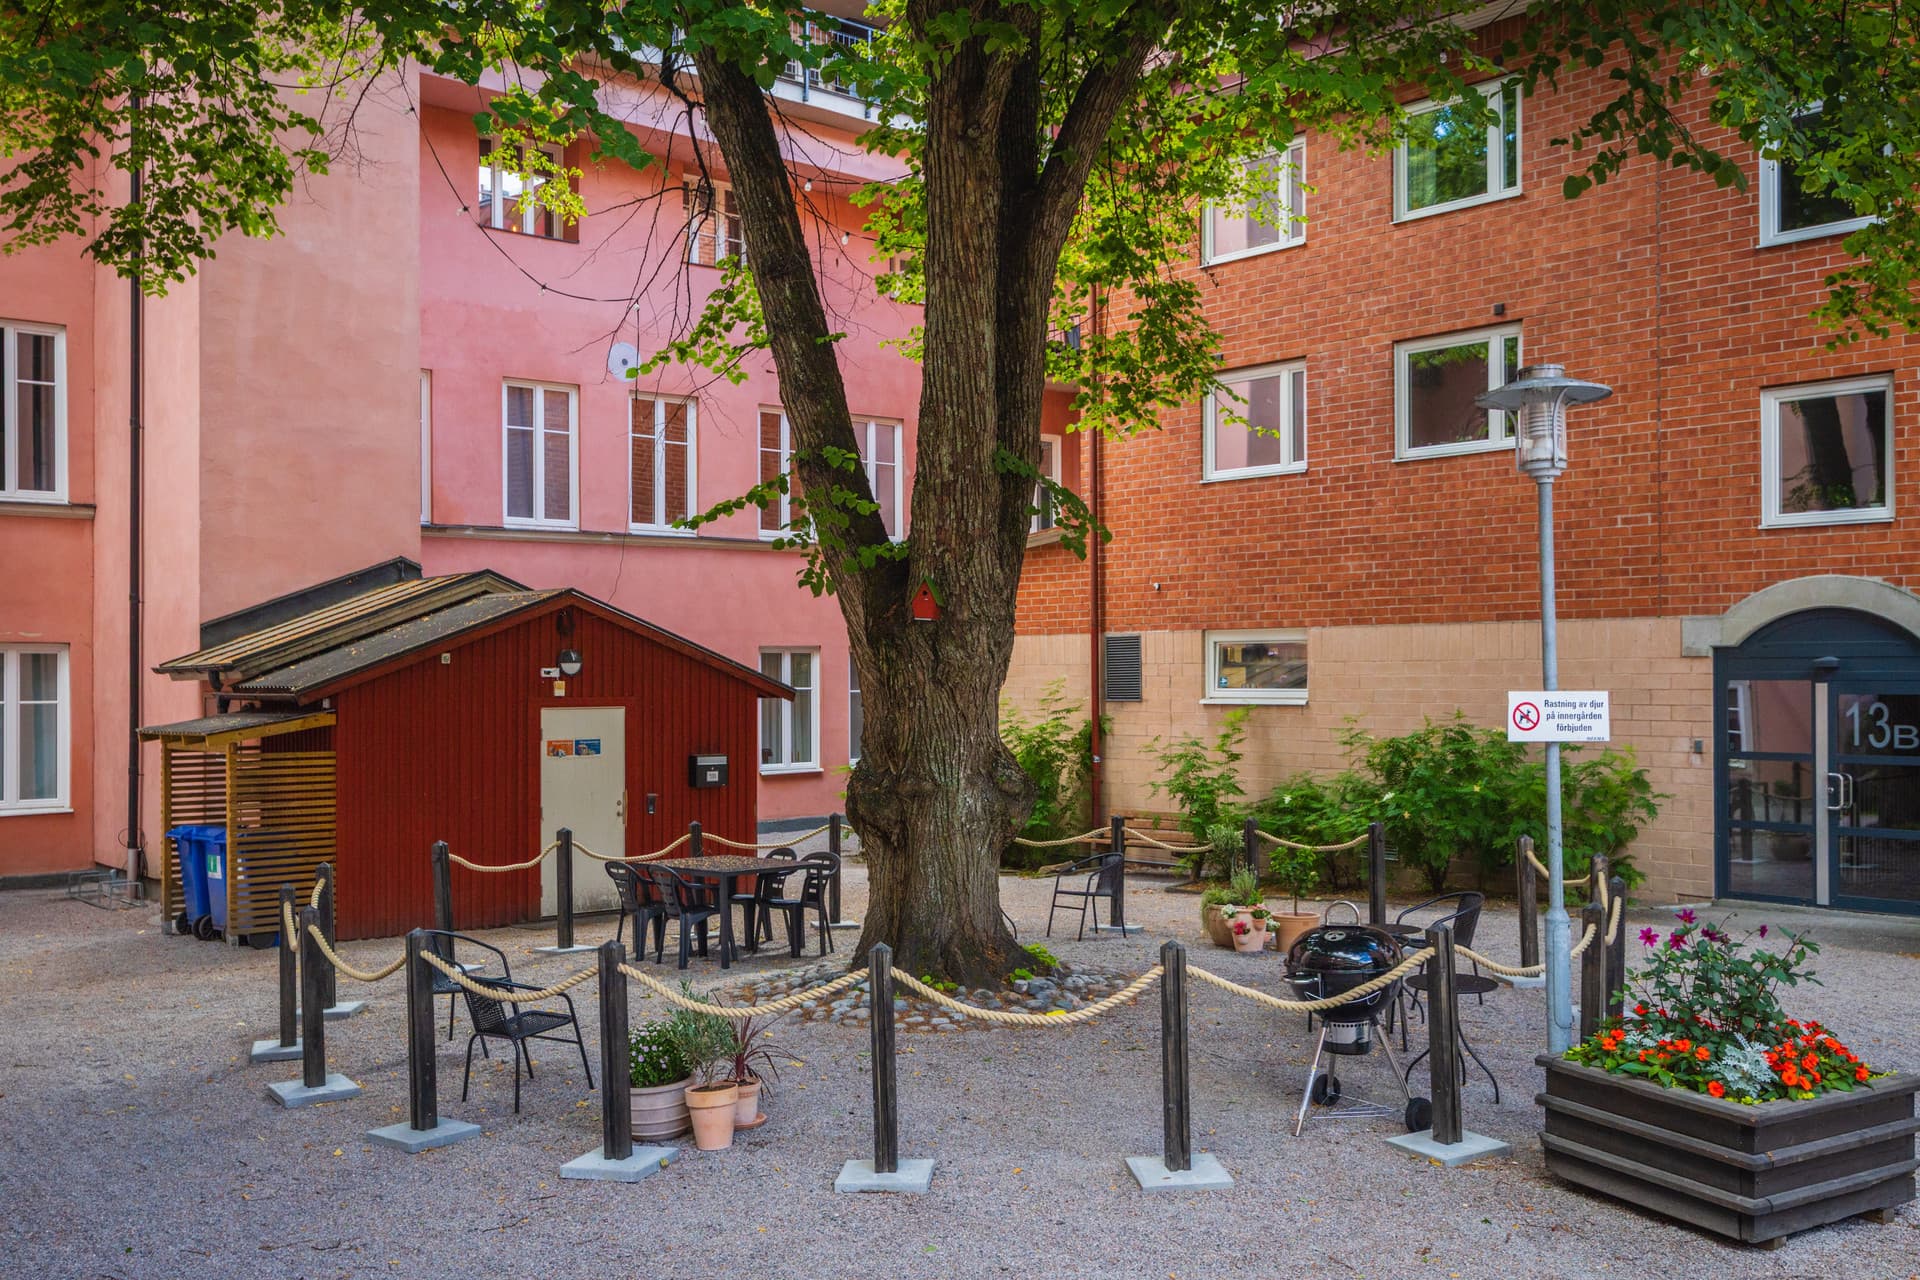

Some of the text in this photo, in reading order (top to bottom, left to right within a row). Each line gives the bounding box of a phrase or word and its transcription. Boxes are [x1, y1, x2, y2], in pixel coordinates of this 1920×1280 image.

[1544, 699, 1576, 709] Rastning
[1589, 699, 1604, 710] djur
[1546, 710, 1602, 721] på innergården
[1556, 722, 1593, 733] förbjuden
[1845, 702, 1920, 749] 13B
